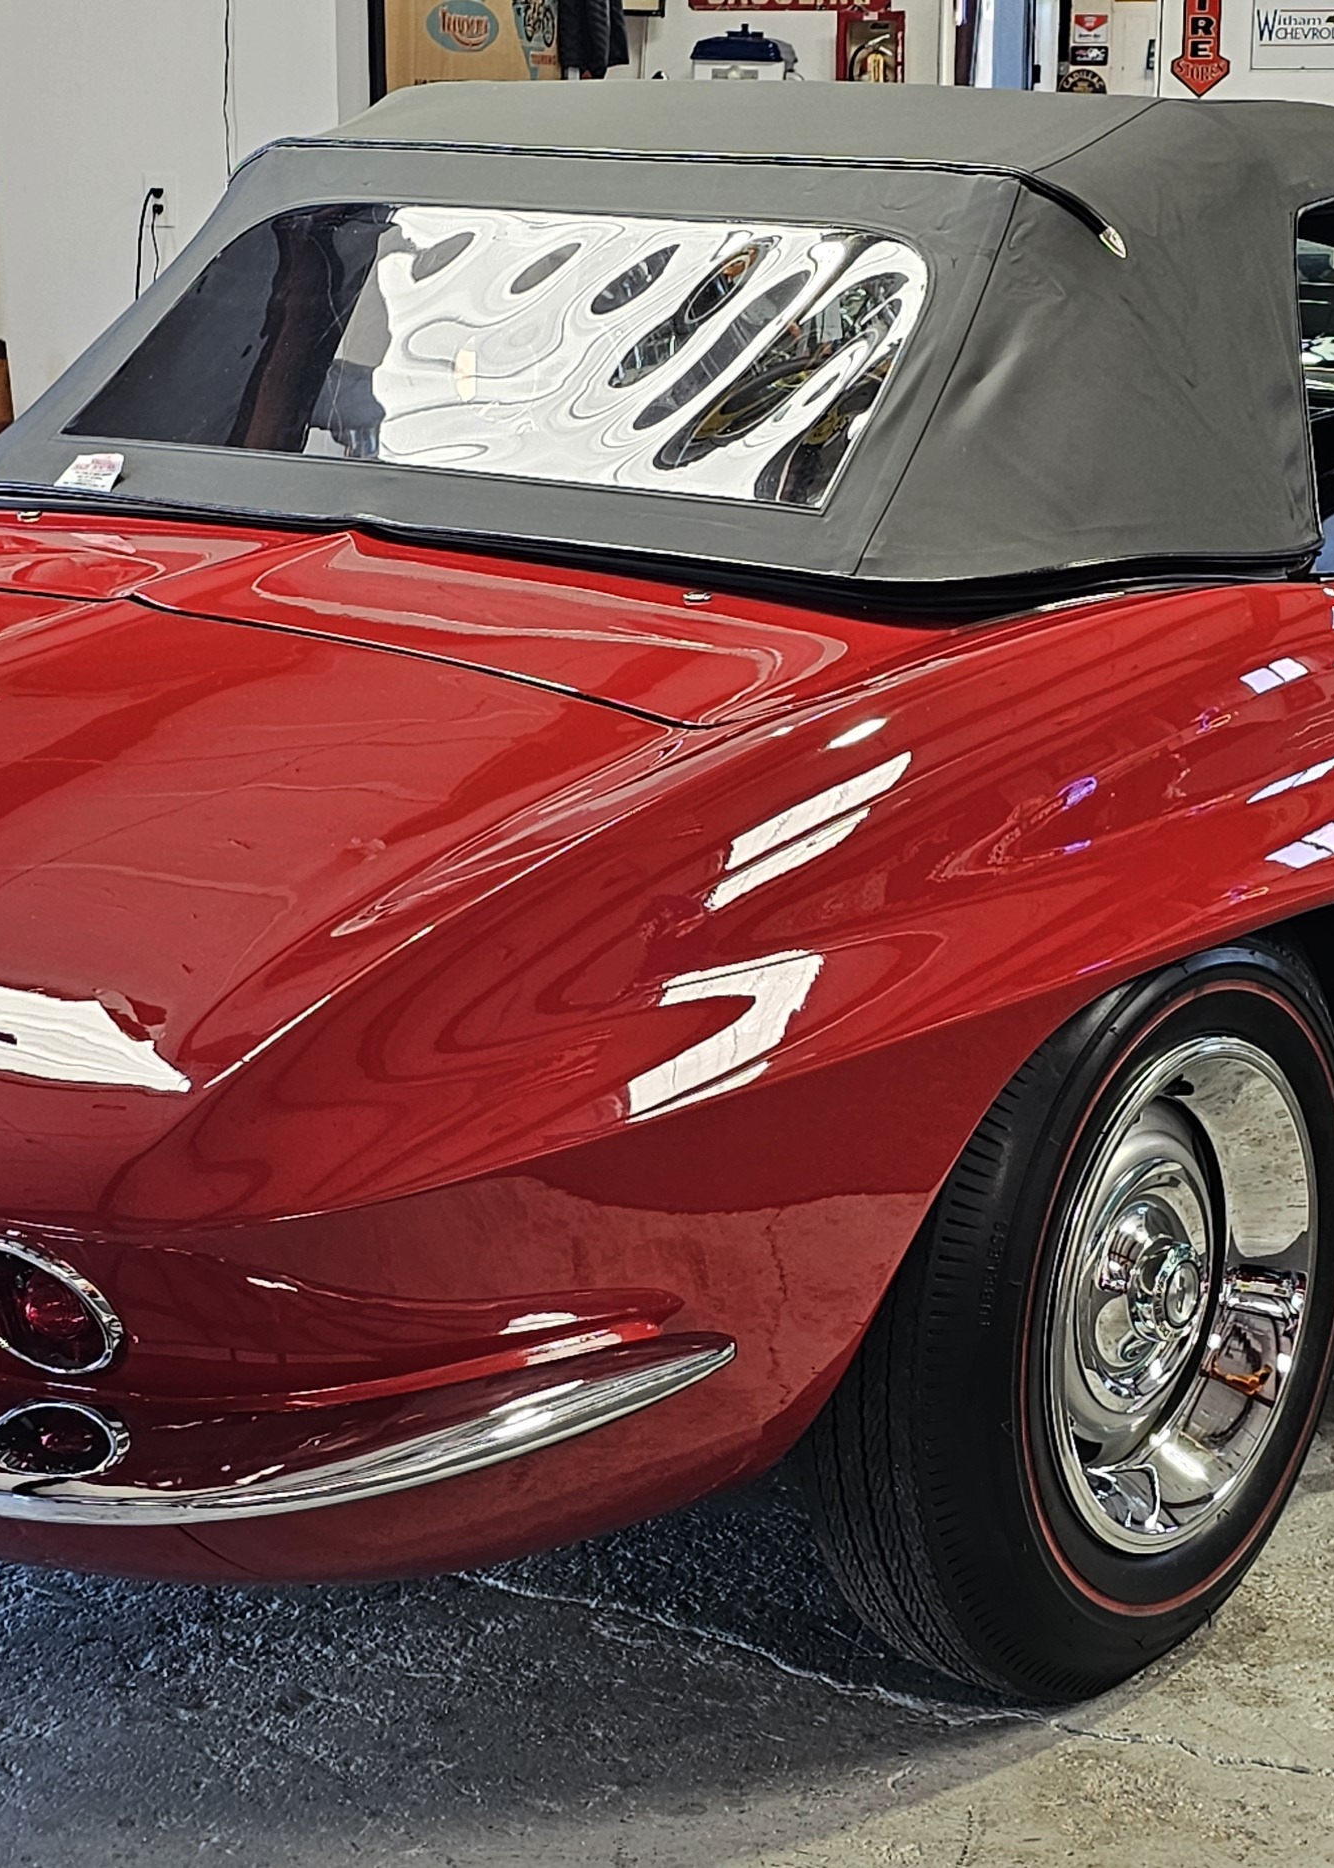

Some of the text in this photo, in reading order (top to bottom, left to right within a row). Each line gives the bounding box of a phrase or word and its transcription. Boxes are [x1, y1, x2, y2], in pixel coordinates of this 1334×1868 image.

[1256, 9, 1322, 41] Witham
[1062, 71, 1104, 89] CADILLAC
[1176, 60, 1227, 82] STORES
